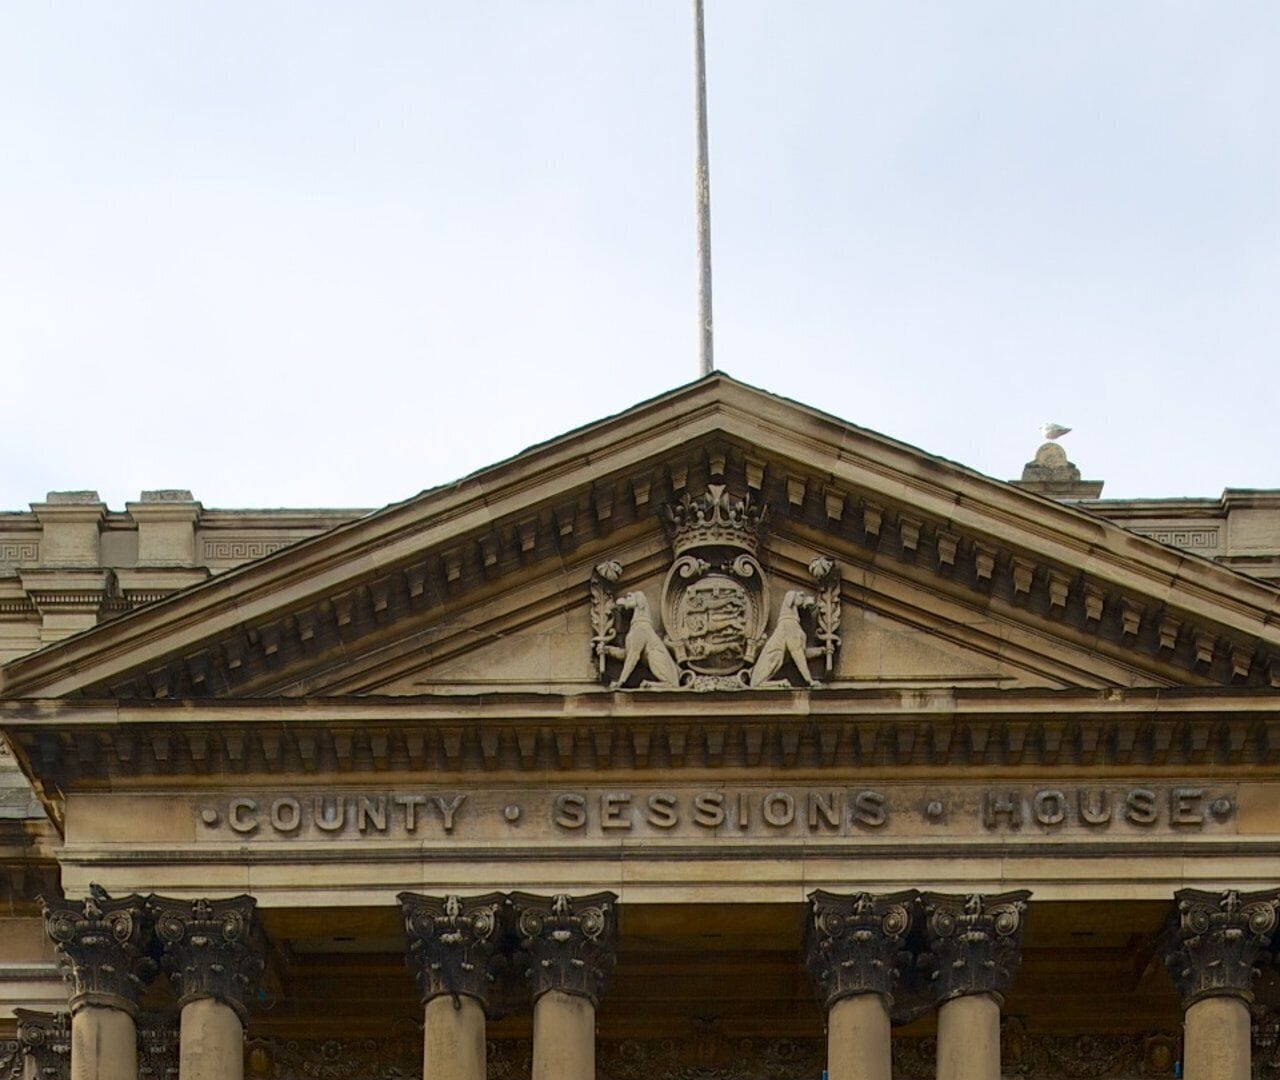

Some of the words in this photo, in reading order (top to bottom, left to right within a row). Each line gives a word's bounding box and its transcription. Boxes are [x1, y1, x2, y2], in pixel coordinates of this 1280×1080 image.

[228, 793, 467, 835] COUNTY
[556, 790, 886, 831] SESSIONS
[983, 787, 1204, 831] HOUSE
